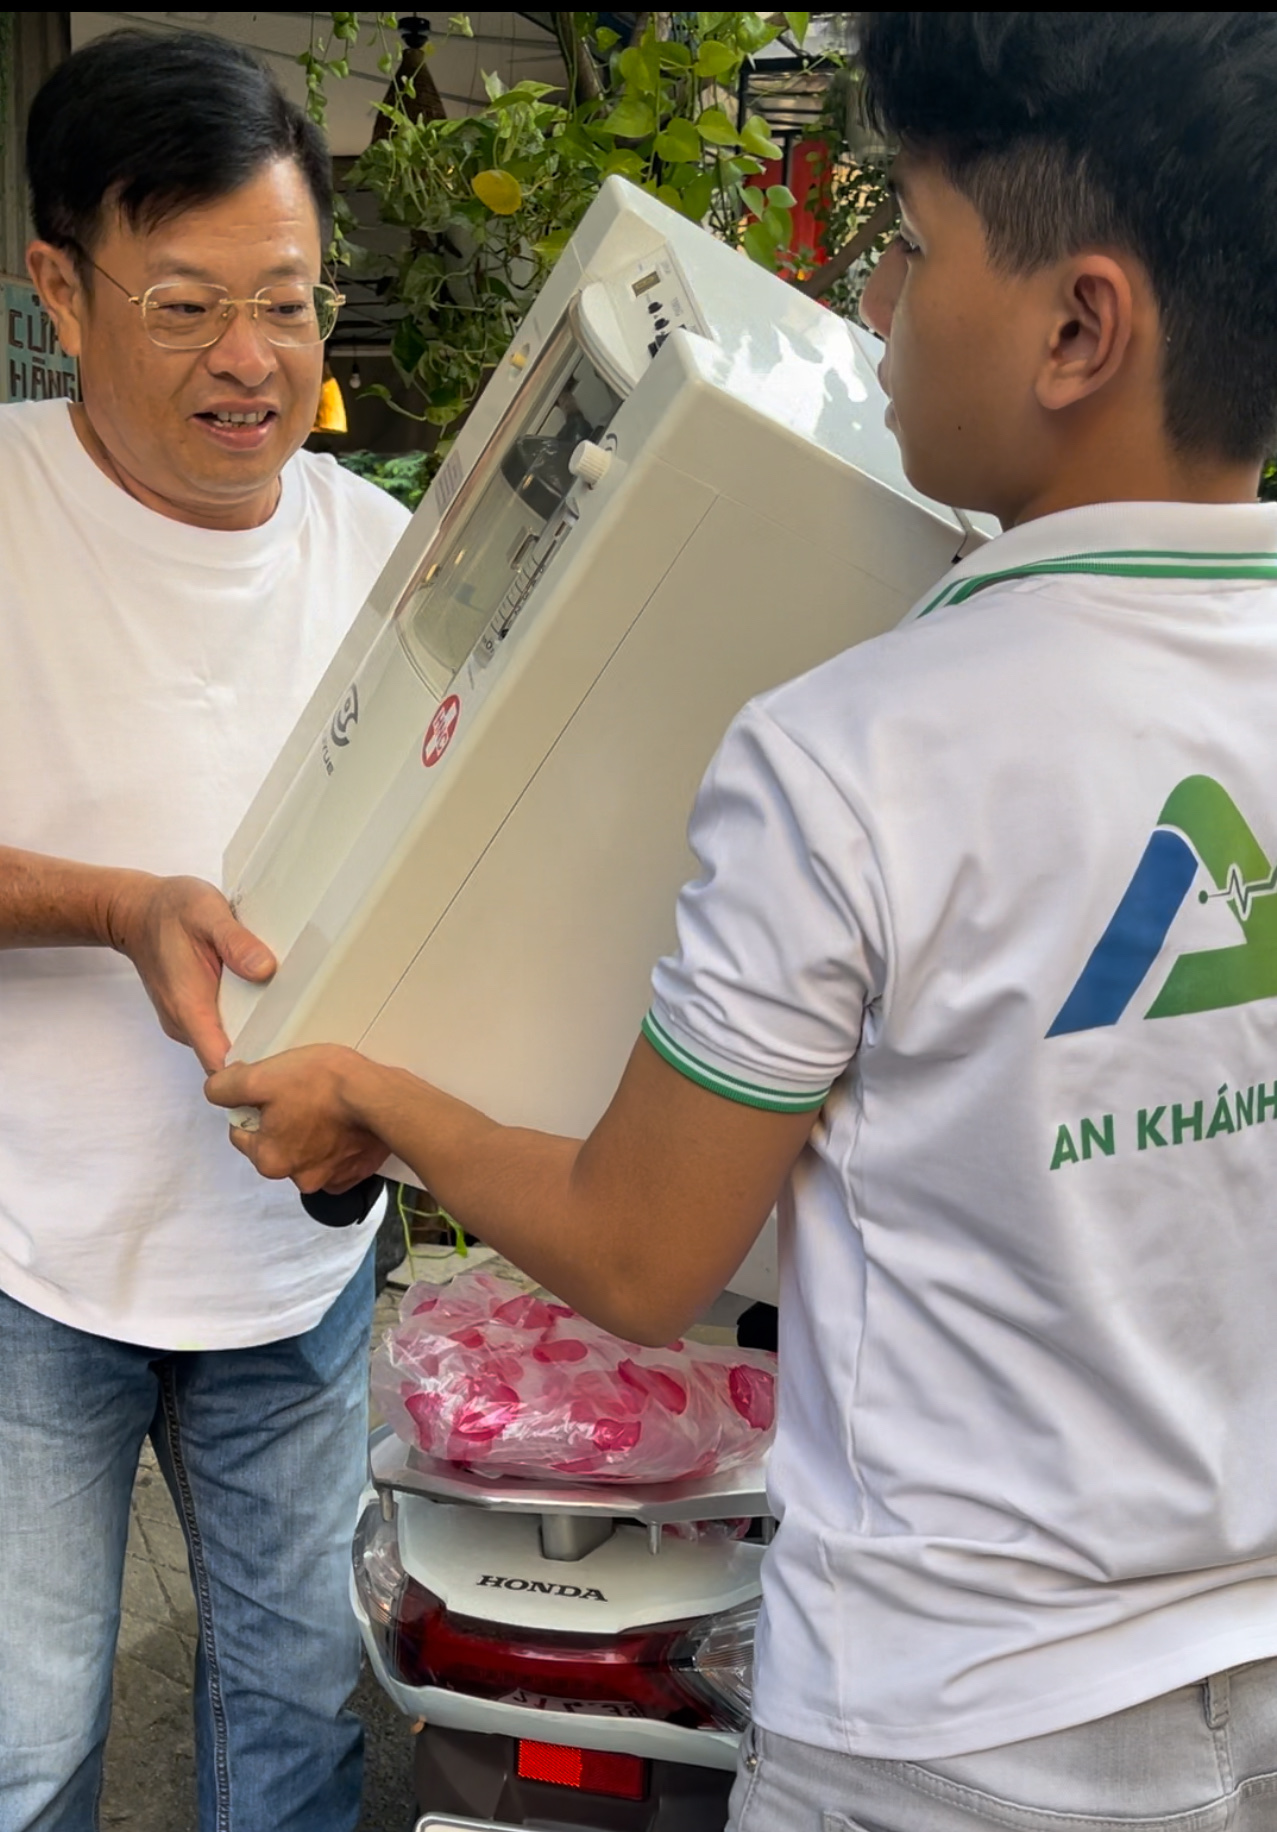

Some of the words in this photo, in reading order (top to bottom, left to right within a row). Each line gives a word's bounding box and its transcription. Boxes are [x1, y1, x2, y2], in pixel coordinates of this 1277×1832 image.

[1050, 1115, 1115, 1170] AN
[1138, 1081, 1277, 1151] KHÁNH
[477, 1575, 608, 1602] HONDA
